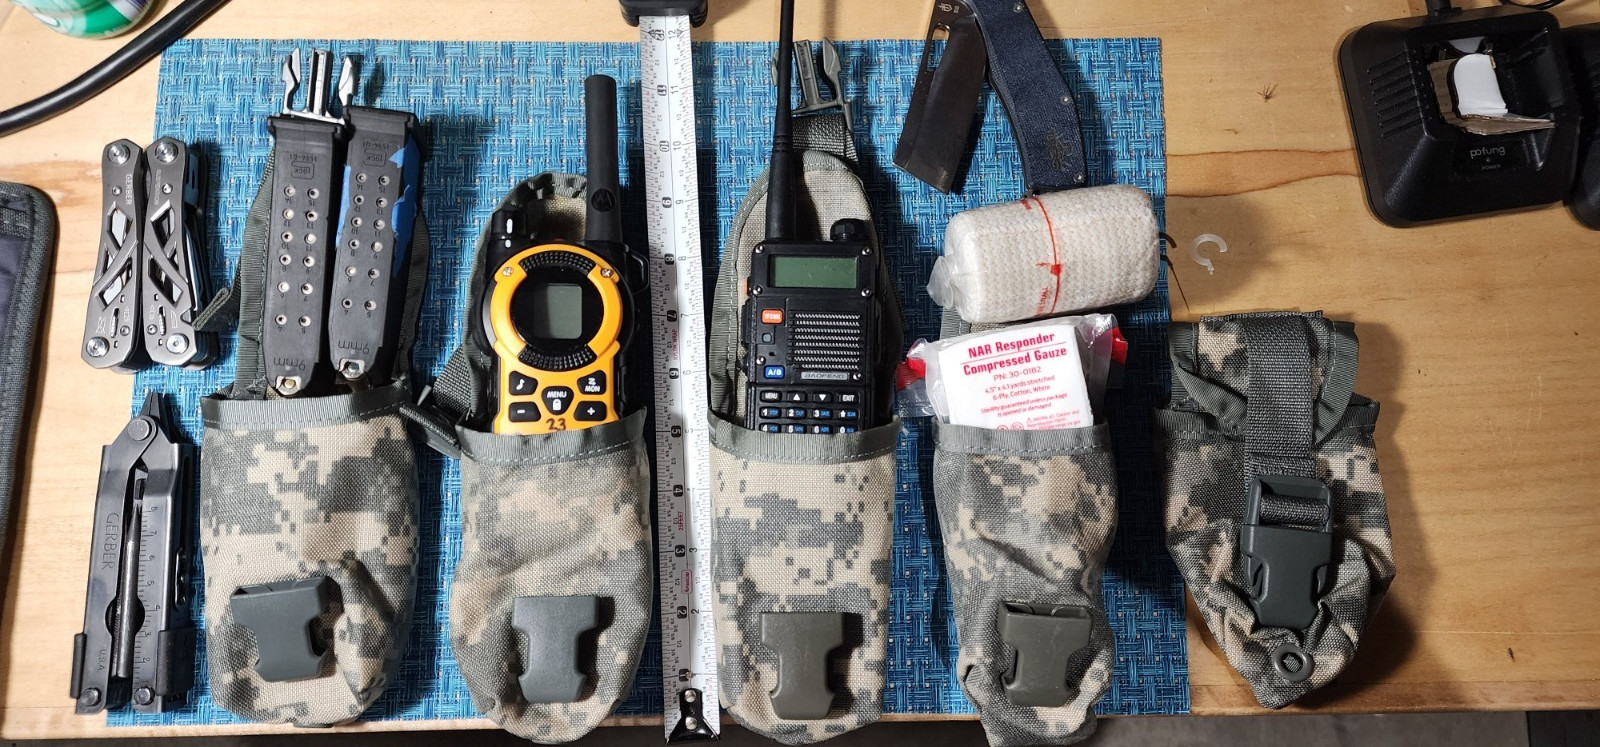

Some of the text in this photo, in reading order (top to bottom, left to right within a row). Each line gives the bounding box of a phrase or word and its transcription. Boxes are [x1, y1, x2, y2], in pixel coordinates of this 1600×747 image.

[655, 29, 665, 41] 12
[668, 30, 676, 39] 12
[657, 84, 667, 96] 11
[670, 85, 678, 94] 11
[659, 140, 670, 152] 10
[673, 140, 682, 151] 10
[1470, 146, 1506, 160] pofung
[338, 340, 370, 354] 9mm
[968, 333, 1055, 358] NAR Responder
[273, 356, 306, 372] 9mm
[963, 347, 1067, 376] Compressed Gauze
[993, 366, 1042, 382] PN: 30-0182
[1010, 380, 1027, 390] yards
[1027, 375, 1055, 386] stretched
[1011, 388, 1032, 397] Cotton,
[1033, 384, 1050, 392] White
[1000, 399, 1029, 411] guaranteed
[1046, 393, 1068, 403] package
[546, 418, 567, 431] 23
[101, 512, 119, 571] GERBER
